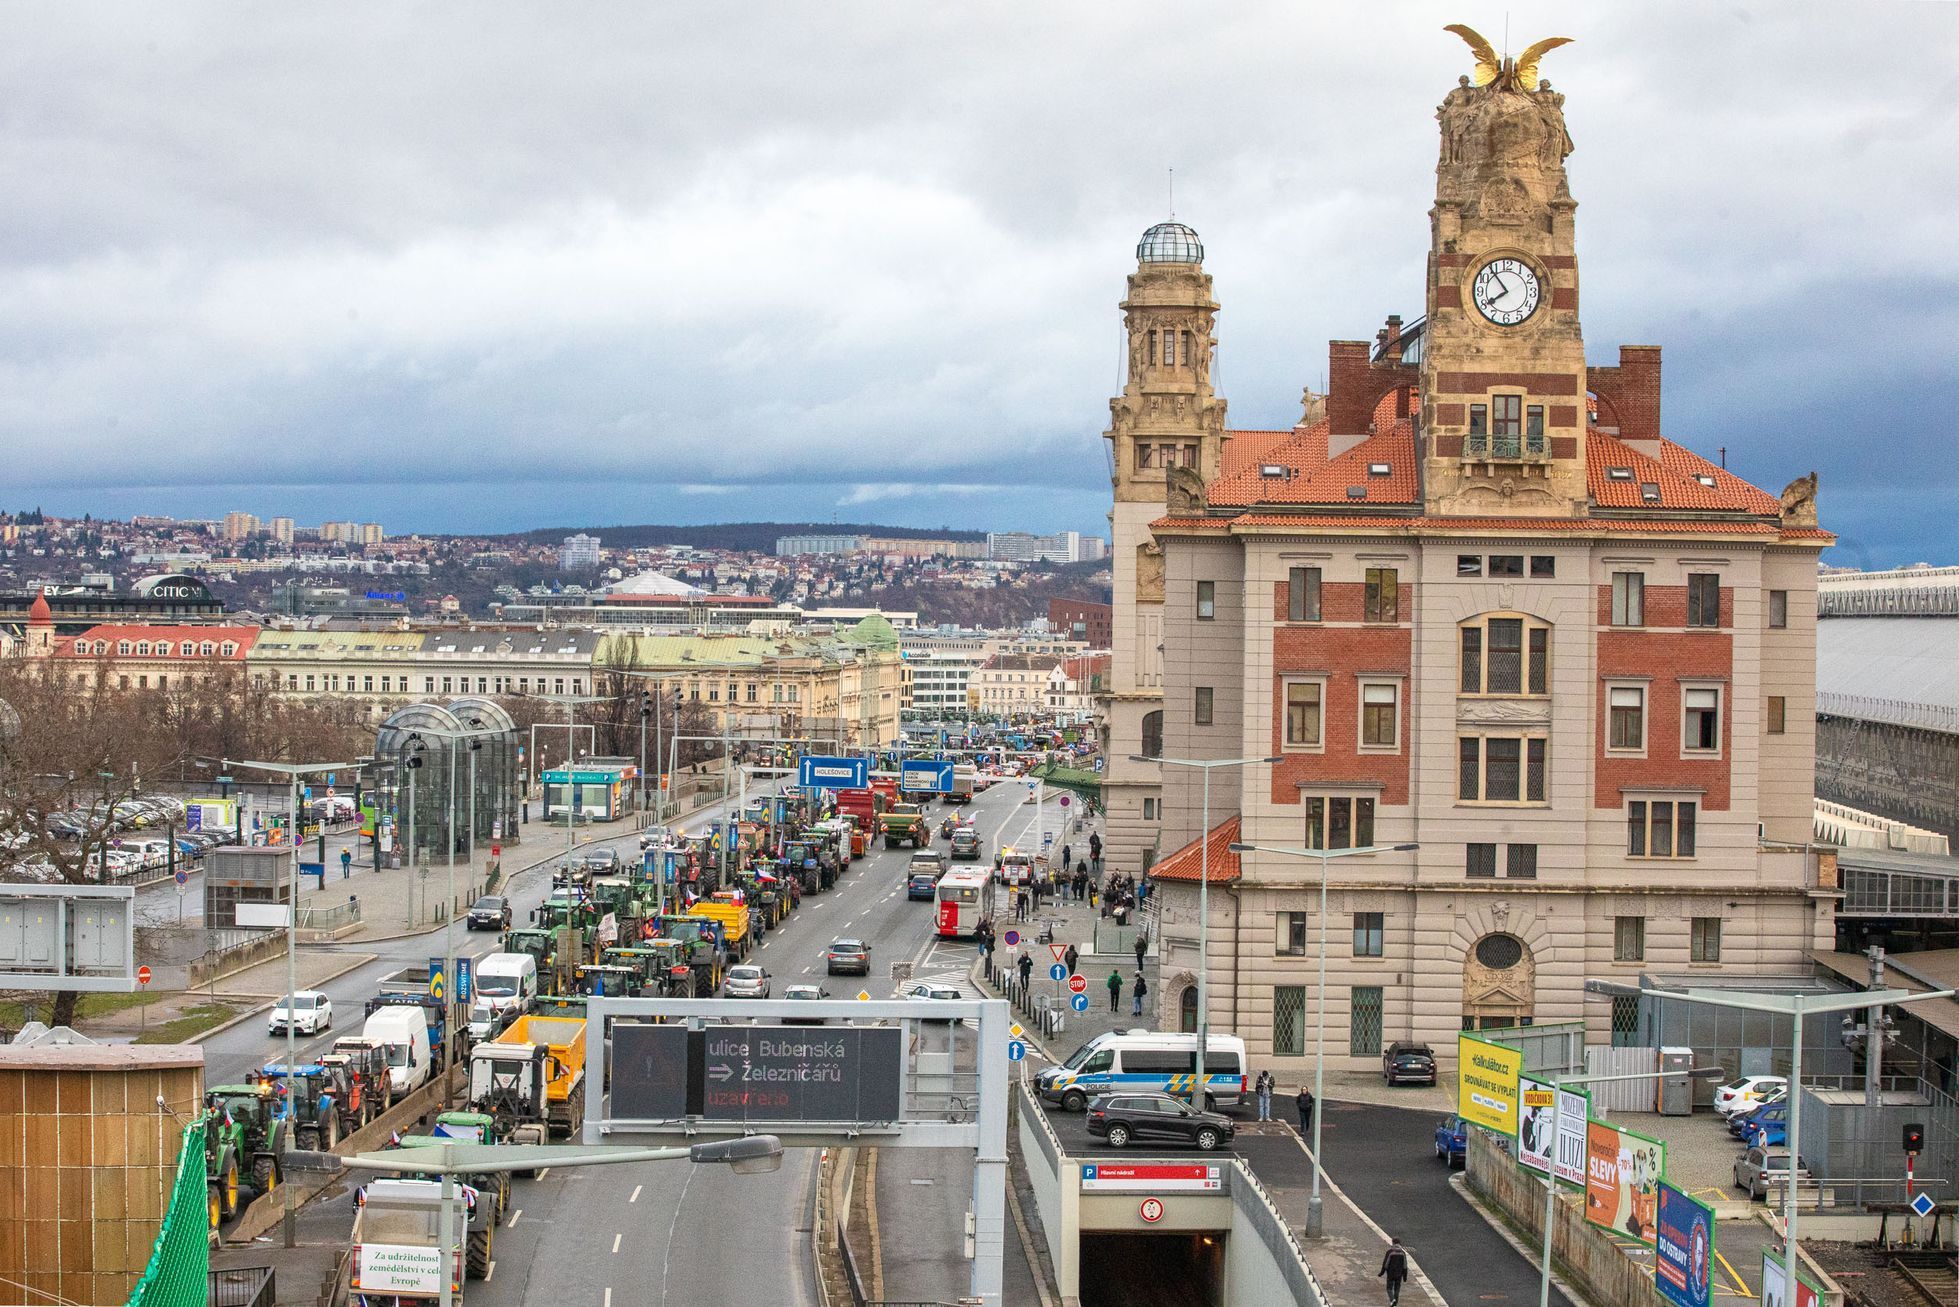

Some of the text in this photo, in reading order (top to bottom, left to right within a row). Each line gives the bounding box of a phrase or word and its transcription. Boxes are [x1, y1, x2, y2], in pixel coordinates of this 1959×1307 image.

[1502, 260, 1513, 271] 12
[1518, 263, 1522, 274] 1
[1480, 272, 1489, 283] 10
[1526, 274, 1534, 284] 2
[1477, 286, 1484, 297] 9
[1529, 287, 1537, 298] 3
[1480, 299, 1487, 310] 8
[1525, 300, 1533, 311] 4
[1491, 310, 1497, 320] 7
[1503, 312, 1510, 324] 6
[1516, 311, 1523, 320] 5
[44, 586, 59, 596] EY
[154, 586, 189, 597] CITIC
[1096, 760, 1102, 770] P
[816, 768, 850, 777] HOLEŠOVICE
[710, 1039, 845, 1057] ulice Bubenská
[1473, 1054, 1508, 1075] Kalkulátor.cz
[742, 1060, 841, 1082] Železničářů
[1464, 1074, 1516, 1099] SROVNÁVAT SE VYPLATÍ
[1547, 1094, 1553, 1105] 31
[1561, 1094, 1585, 1118] MUZEUM
[1560, 1134, 1584, 1170] ILUZÍ
[1572, 1168, 1584, 1182] Praze
[1590, 1156, 1616, 1183] SLEVY
[374, 1251, 438, 1262] Za udržitelnost
[1660, 1236, 1688, 1266] DO OSTRAVY
[369, 1264, 419, 1274] zemědělství
[391, 1276, 421, 1286] Evropě
